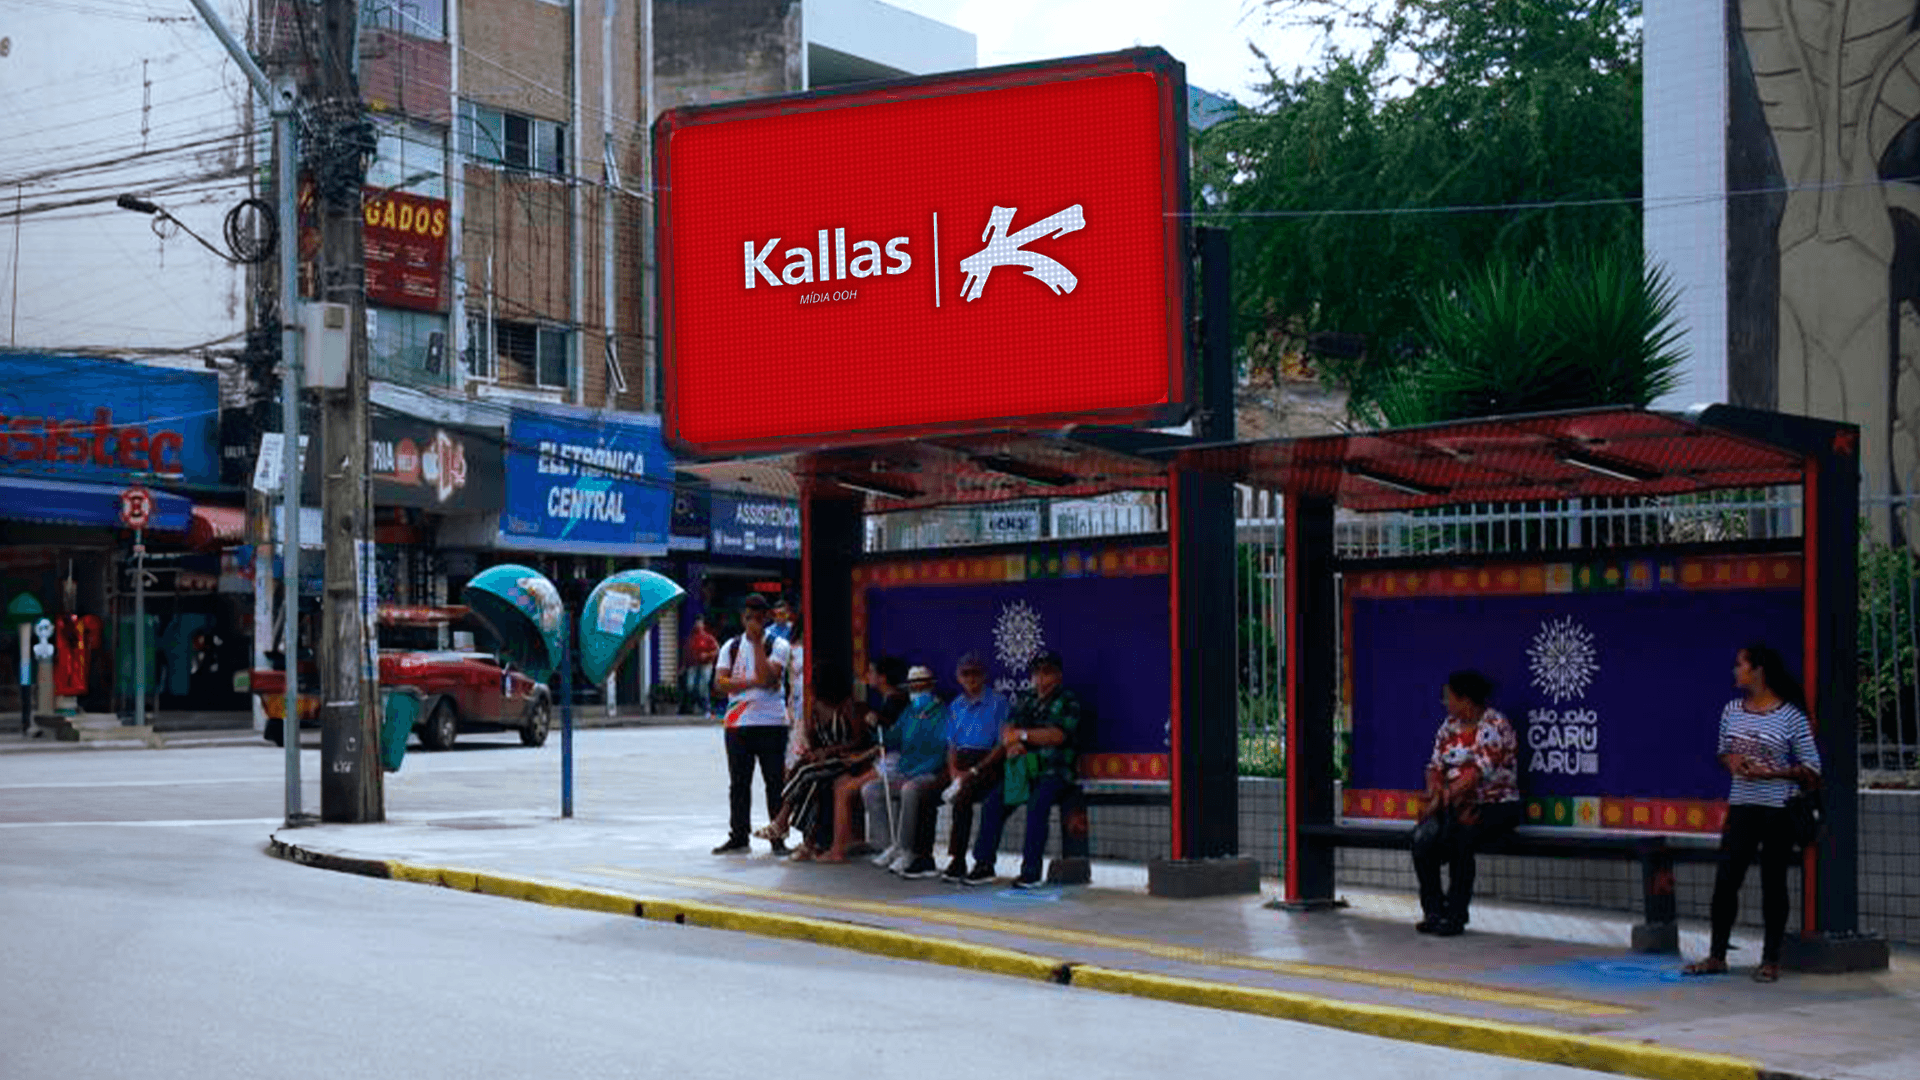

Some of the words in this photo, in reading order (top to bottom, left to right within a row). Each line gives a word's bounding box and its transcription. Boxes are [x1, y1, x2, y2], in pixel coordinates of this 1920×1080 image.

[744, 227, 912, 289] Kallas
[799, 290, 831, 305] MÍDIA
[832, 289, 858, 302] OOH
[547, 485, 626, 523] CENTRAL
[1527, 707, 1558, 724] SÃO
[1560, 707, 1598, 725] JOÃO
[1527, 724, 1598, 751] CARU
[1527, 750, 1580, 775] ARU
